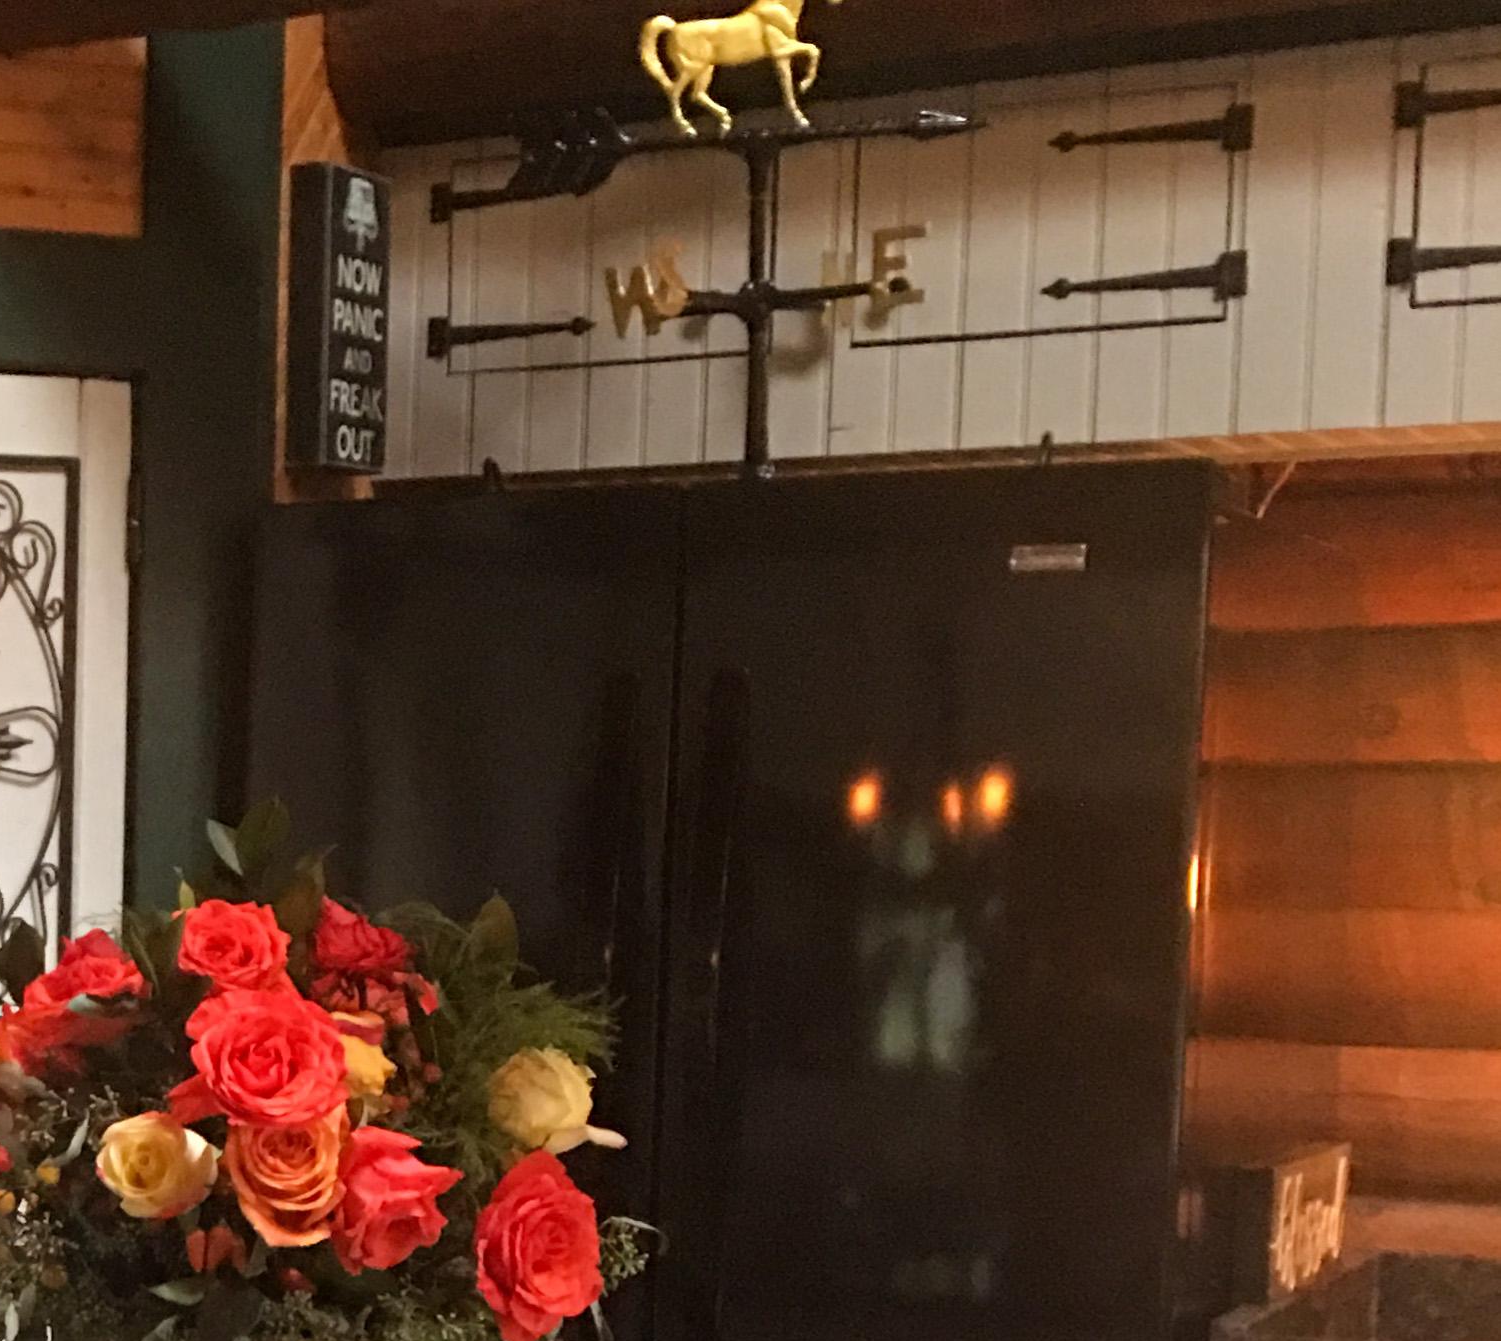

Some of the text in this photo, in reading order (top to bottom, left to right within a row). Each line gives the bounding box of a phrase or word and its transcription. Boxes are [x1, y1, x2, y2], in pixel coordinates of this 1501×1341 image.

[336, 253, 383, 297] NOW
[332, 298, 384, 342] PANIC
[330, 378, 384, 422] FREAK
[336, 424, 375, 462] OUT
